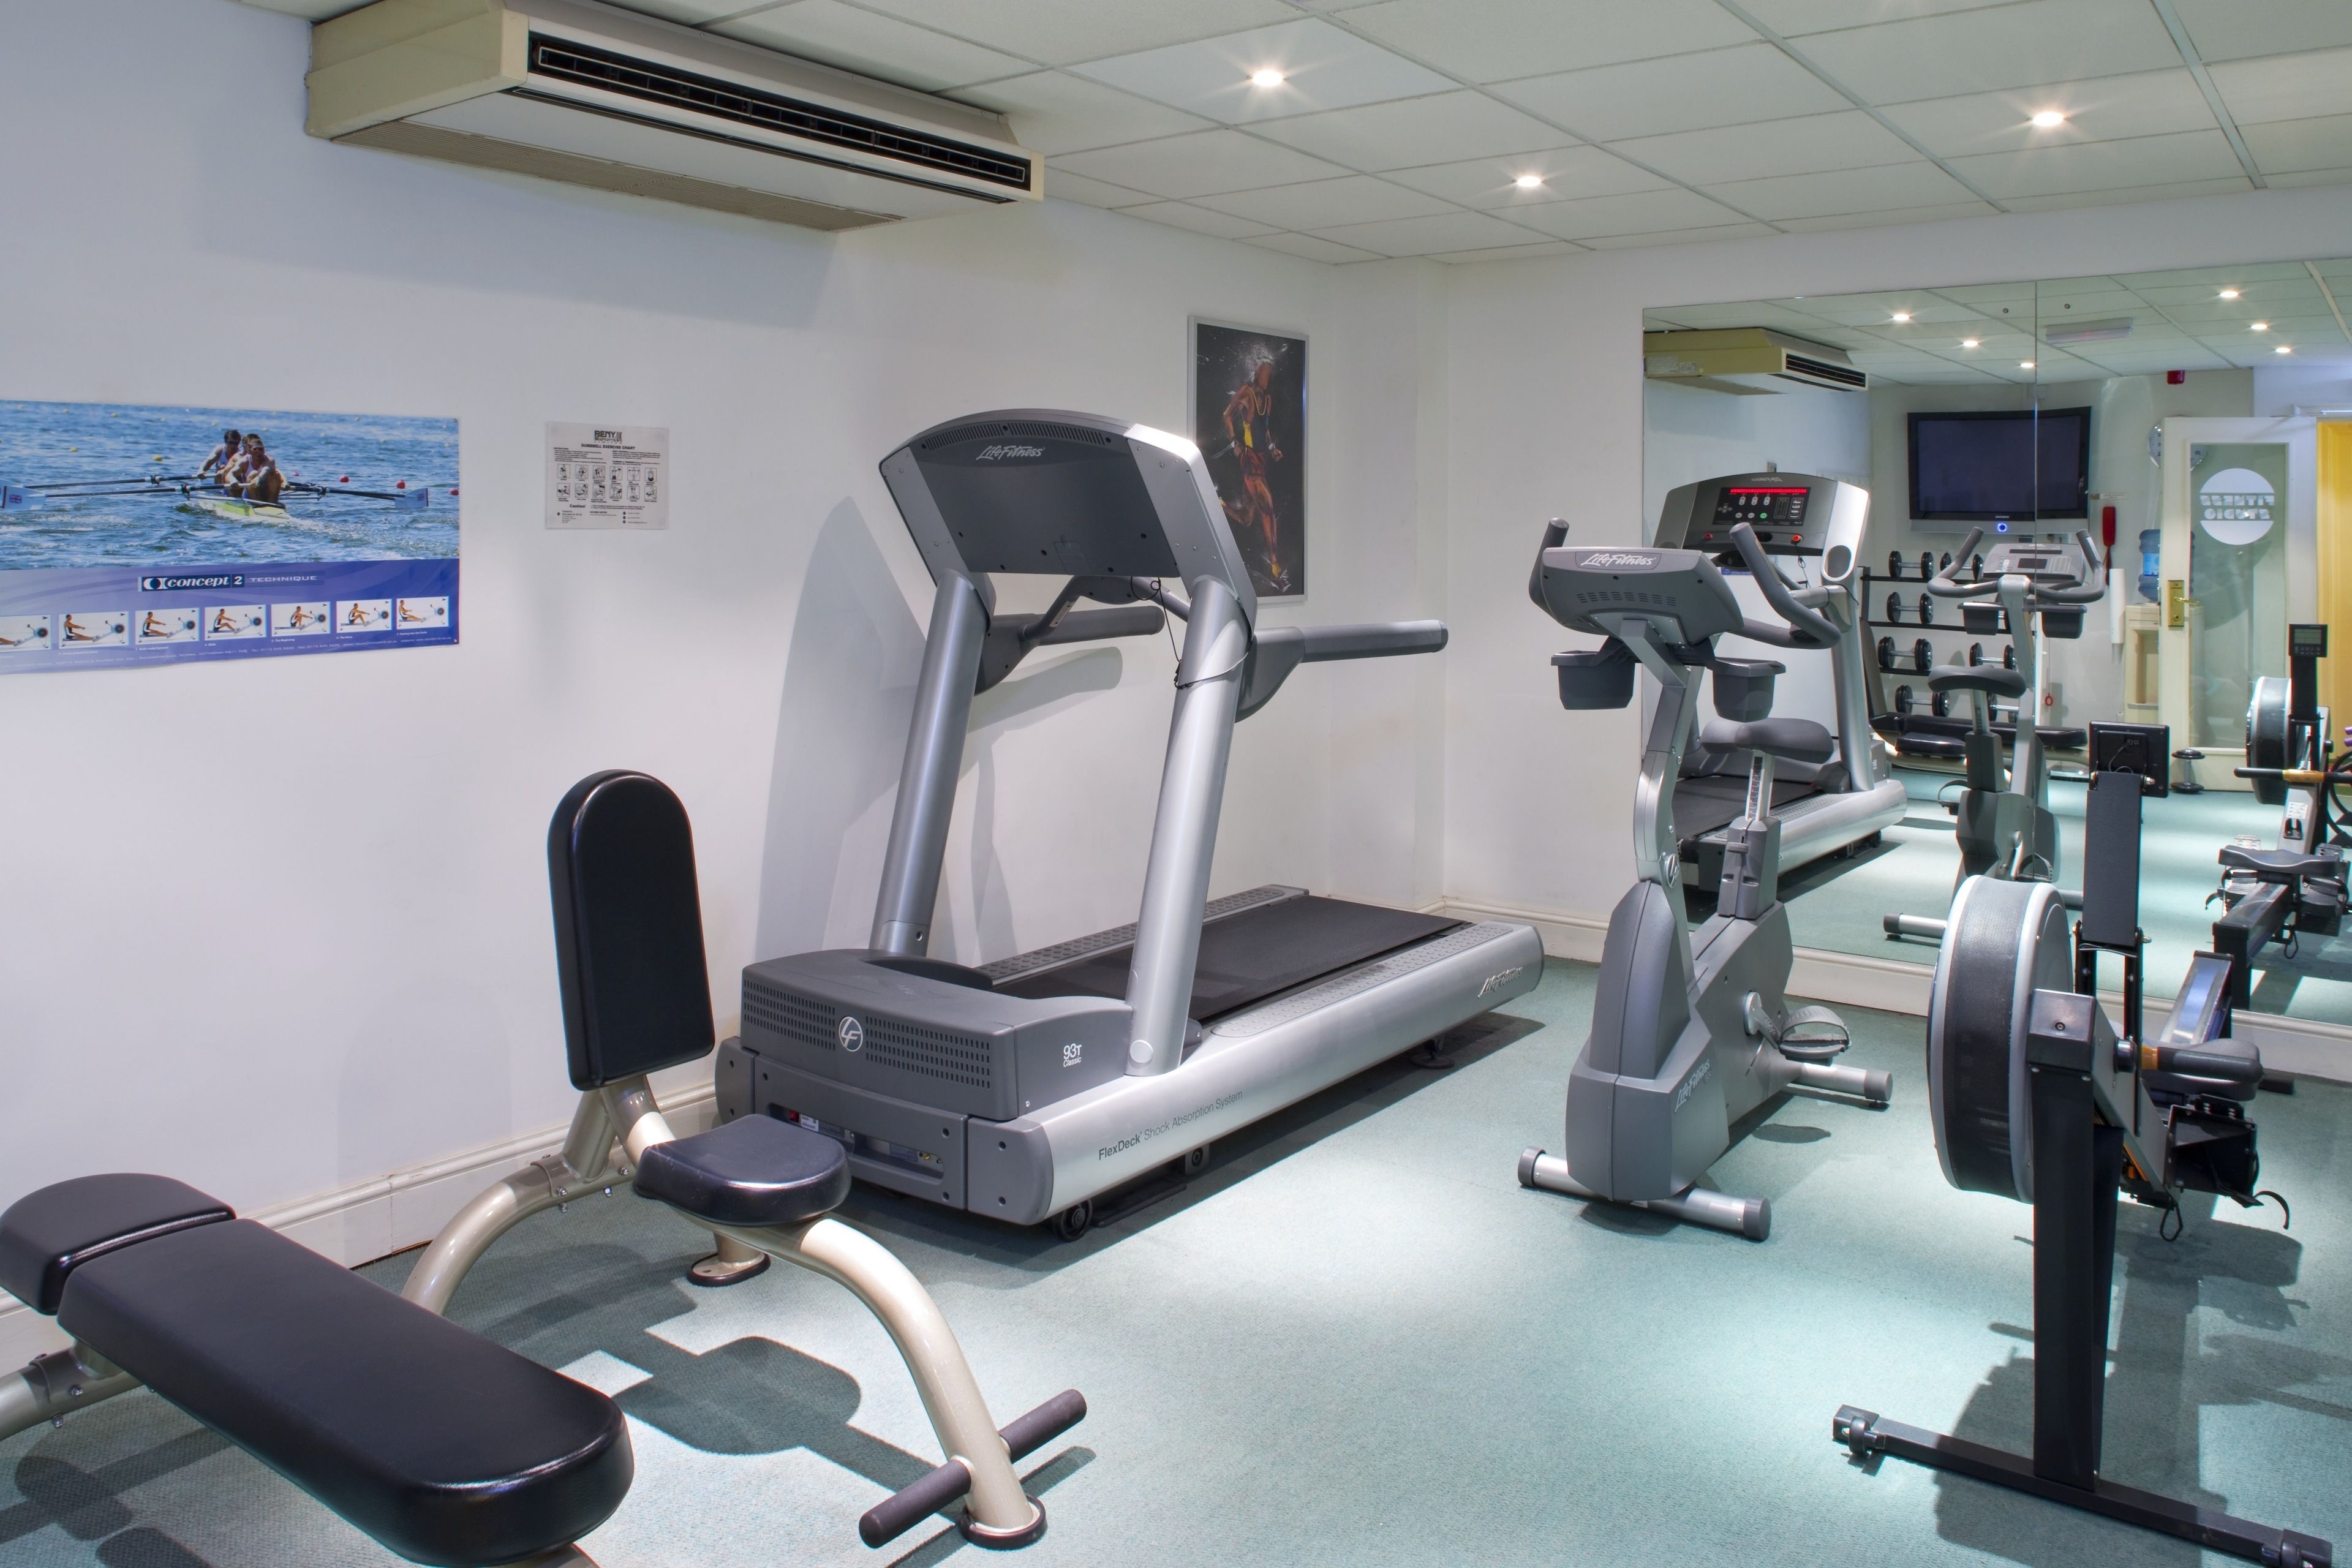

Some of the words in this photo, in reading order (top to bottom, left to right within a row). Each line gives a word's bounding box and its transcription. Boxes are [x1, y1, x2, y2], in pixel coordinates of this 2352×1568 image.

[595, 430, 616, 439] BENY
[167, 576, 229, 588] concept
[233, 576, 243, 585] 2
[1063, 1043, 1082, 1060] 93T
[1063, 1056, 1082, 1068] Classic
[1144, 1121, 1170, 1140] Shock
[1172, 1103, 1214, 1129] Absorption
[1216, 1091, 1243, 1110] System
